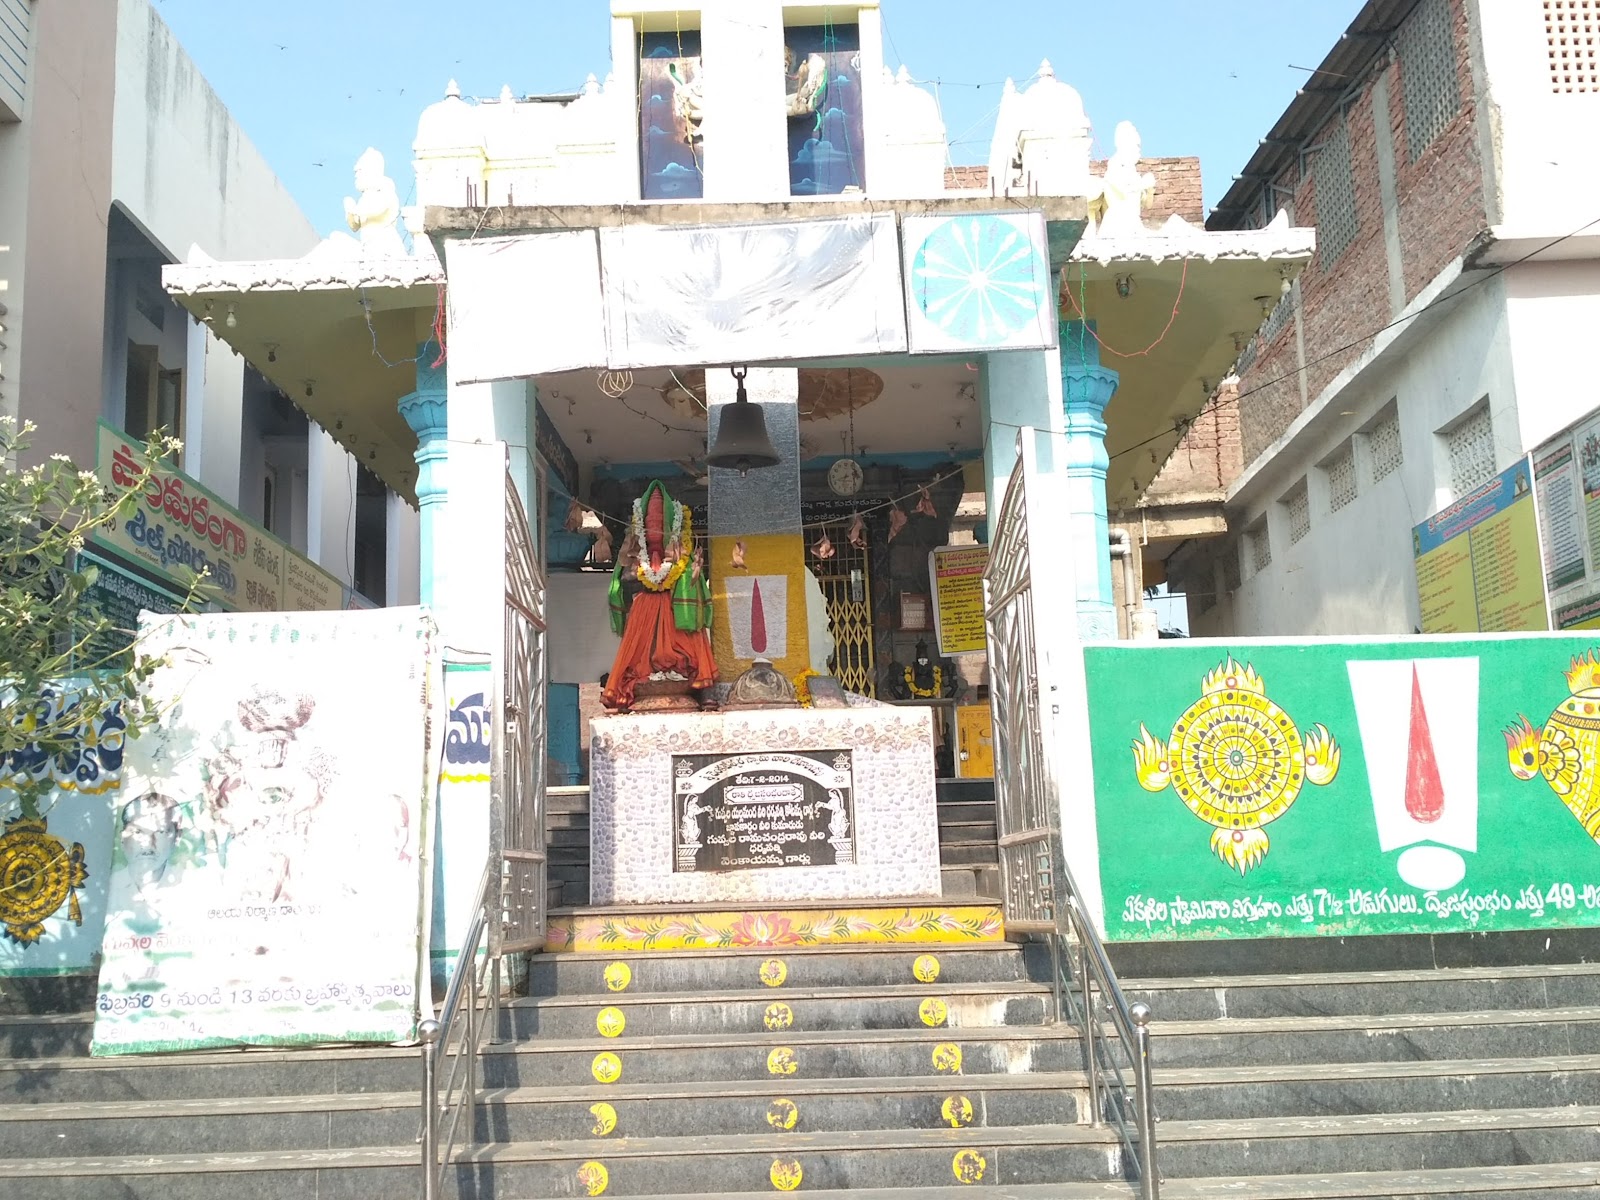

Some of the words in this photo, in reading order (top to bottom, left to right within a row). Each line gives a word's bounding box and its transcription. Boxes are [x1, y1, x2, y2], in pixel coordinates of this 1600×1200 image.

[1285, 893, 1314, 923] ఎత్తు
[1515, 884, 1545, 918] ఎత్తు
[1546, 882, 1576, 909] 49
[177, 986, 222, 1007] నుండి
[230, 989, 252, 1005] 13
